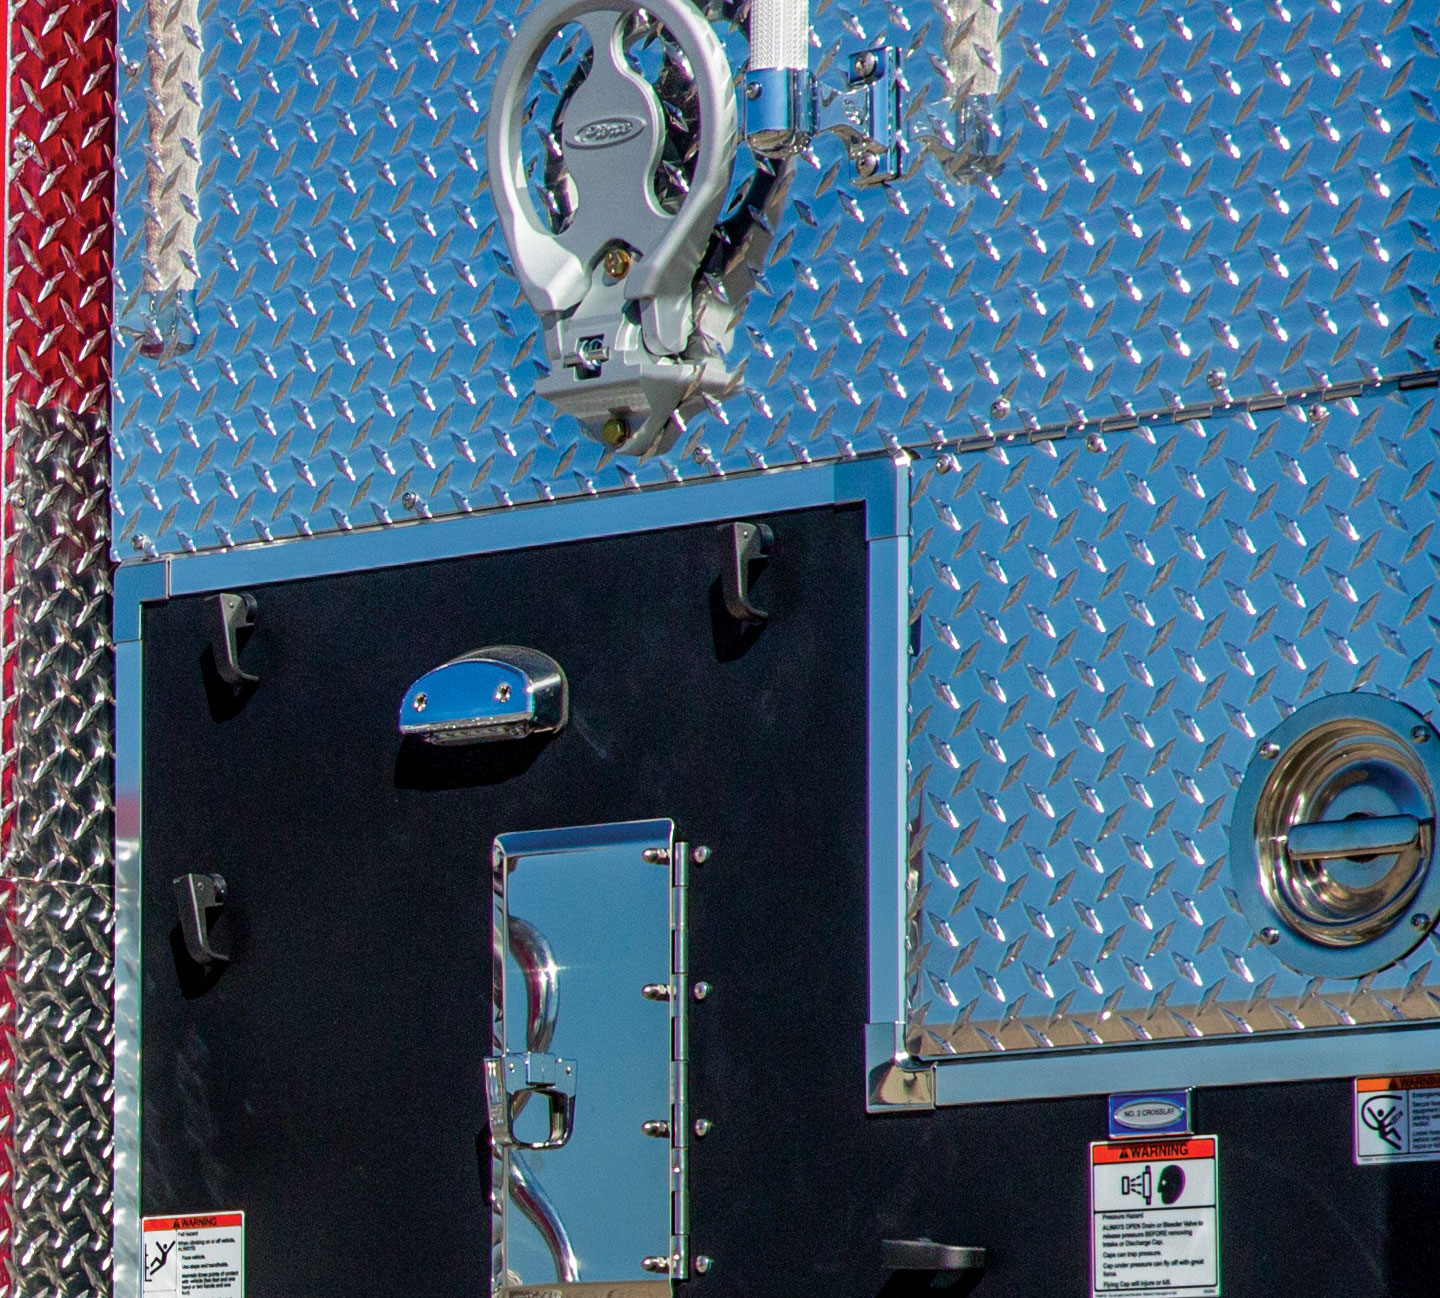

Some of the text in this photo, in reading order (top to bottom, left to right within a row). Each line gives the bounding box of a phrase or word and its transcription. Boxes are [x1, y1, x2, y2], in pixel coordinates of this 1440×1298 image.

[1142, 1108, 1175, 1117] CROSSLAY
[1130, 1143, 1188, 1158] WARNING
[182, 1216, 217, 1227] WARNING
